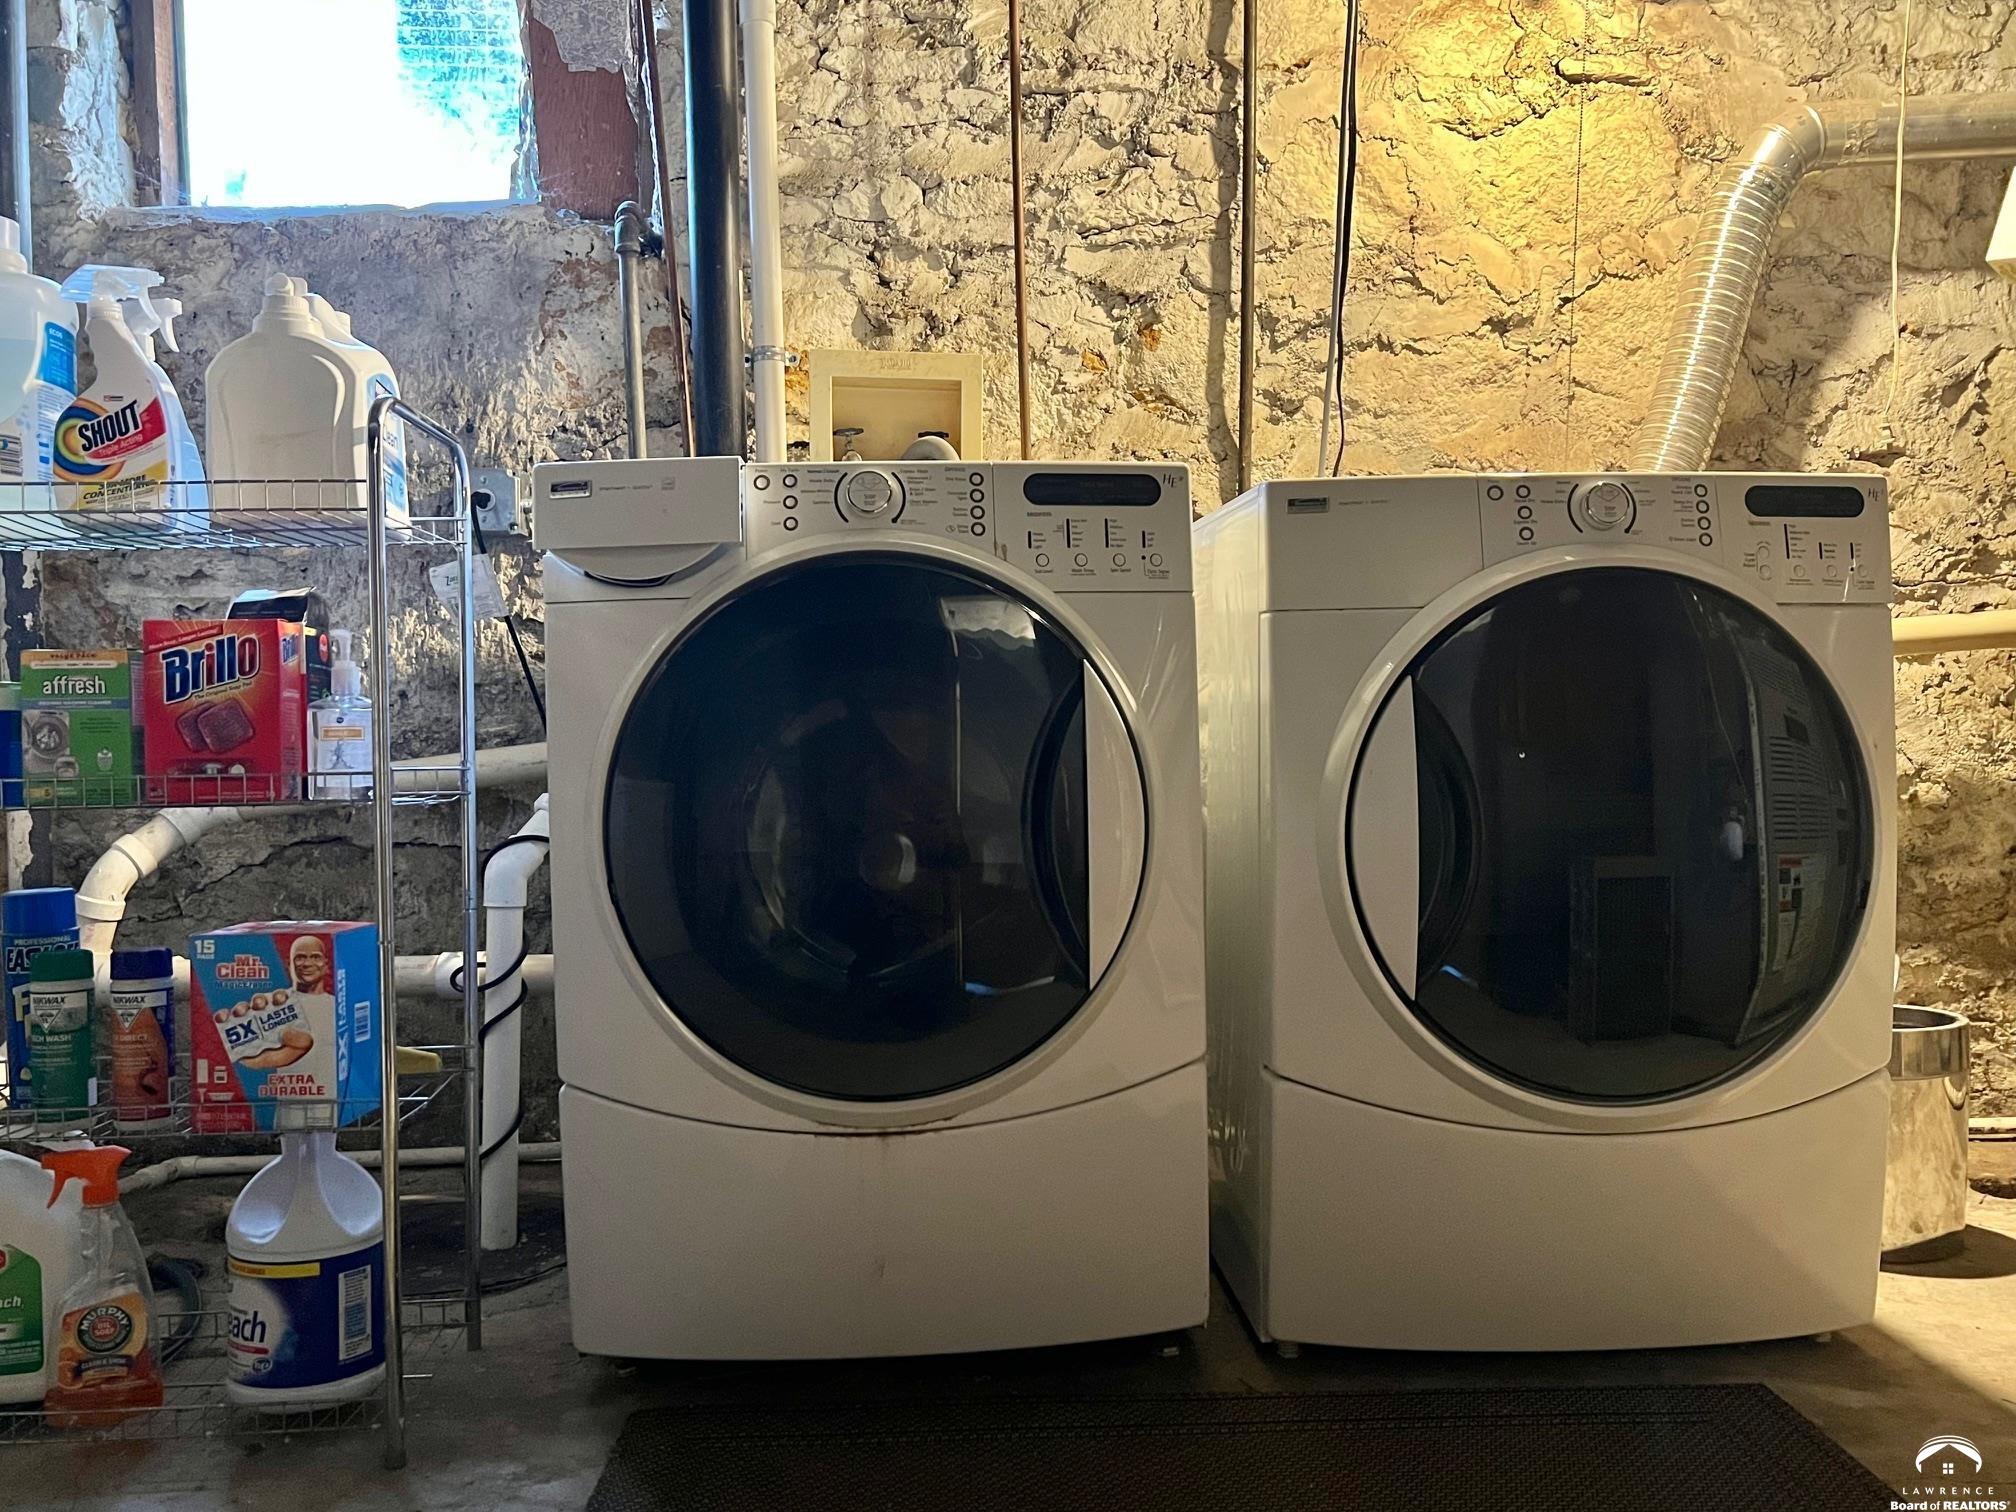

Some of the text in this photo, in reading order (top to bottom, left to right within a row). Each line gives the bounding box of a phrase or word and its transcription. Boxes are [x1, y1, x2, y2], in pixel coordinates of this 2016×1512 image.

[77, 399, 140, 452] SHOUT
[160, 633, 260, 704] Brillo
[42, 675, 106, 695] affresh
[14, 935, 71, 946] PROFESSIONAL
[194, 939, 216, 954] 15
[234, 954, 263, 967] Mr.
[215, 962, 270, 980] Clean
[32, 996, 66, 1004] NIKWAX
[112, 995, 147, 1004] NIKWAX
[259, 1004, 296, 1024] LASTS
[262, 1013, 298, 1032] LONGER
[45, 1034, 72, 1042] WASH
[224, 1019, 258, 1045] 5X
[267, 1073, 316, 1086] EXTRA
[258, 1085, 326, 1097] DURABLE
[80, 1307, 129, 1330] MURPHY
